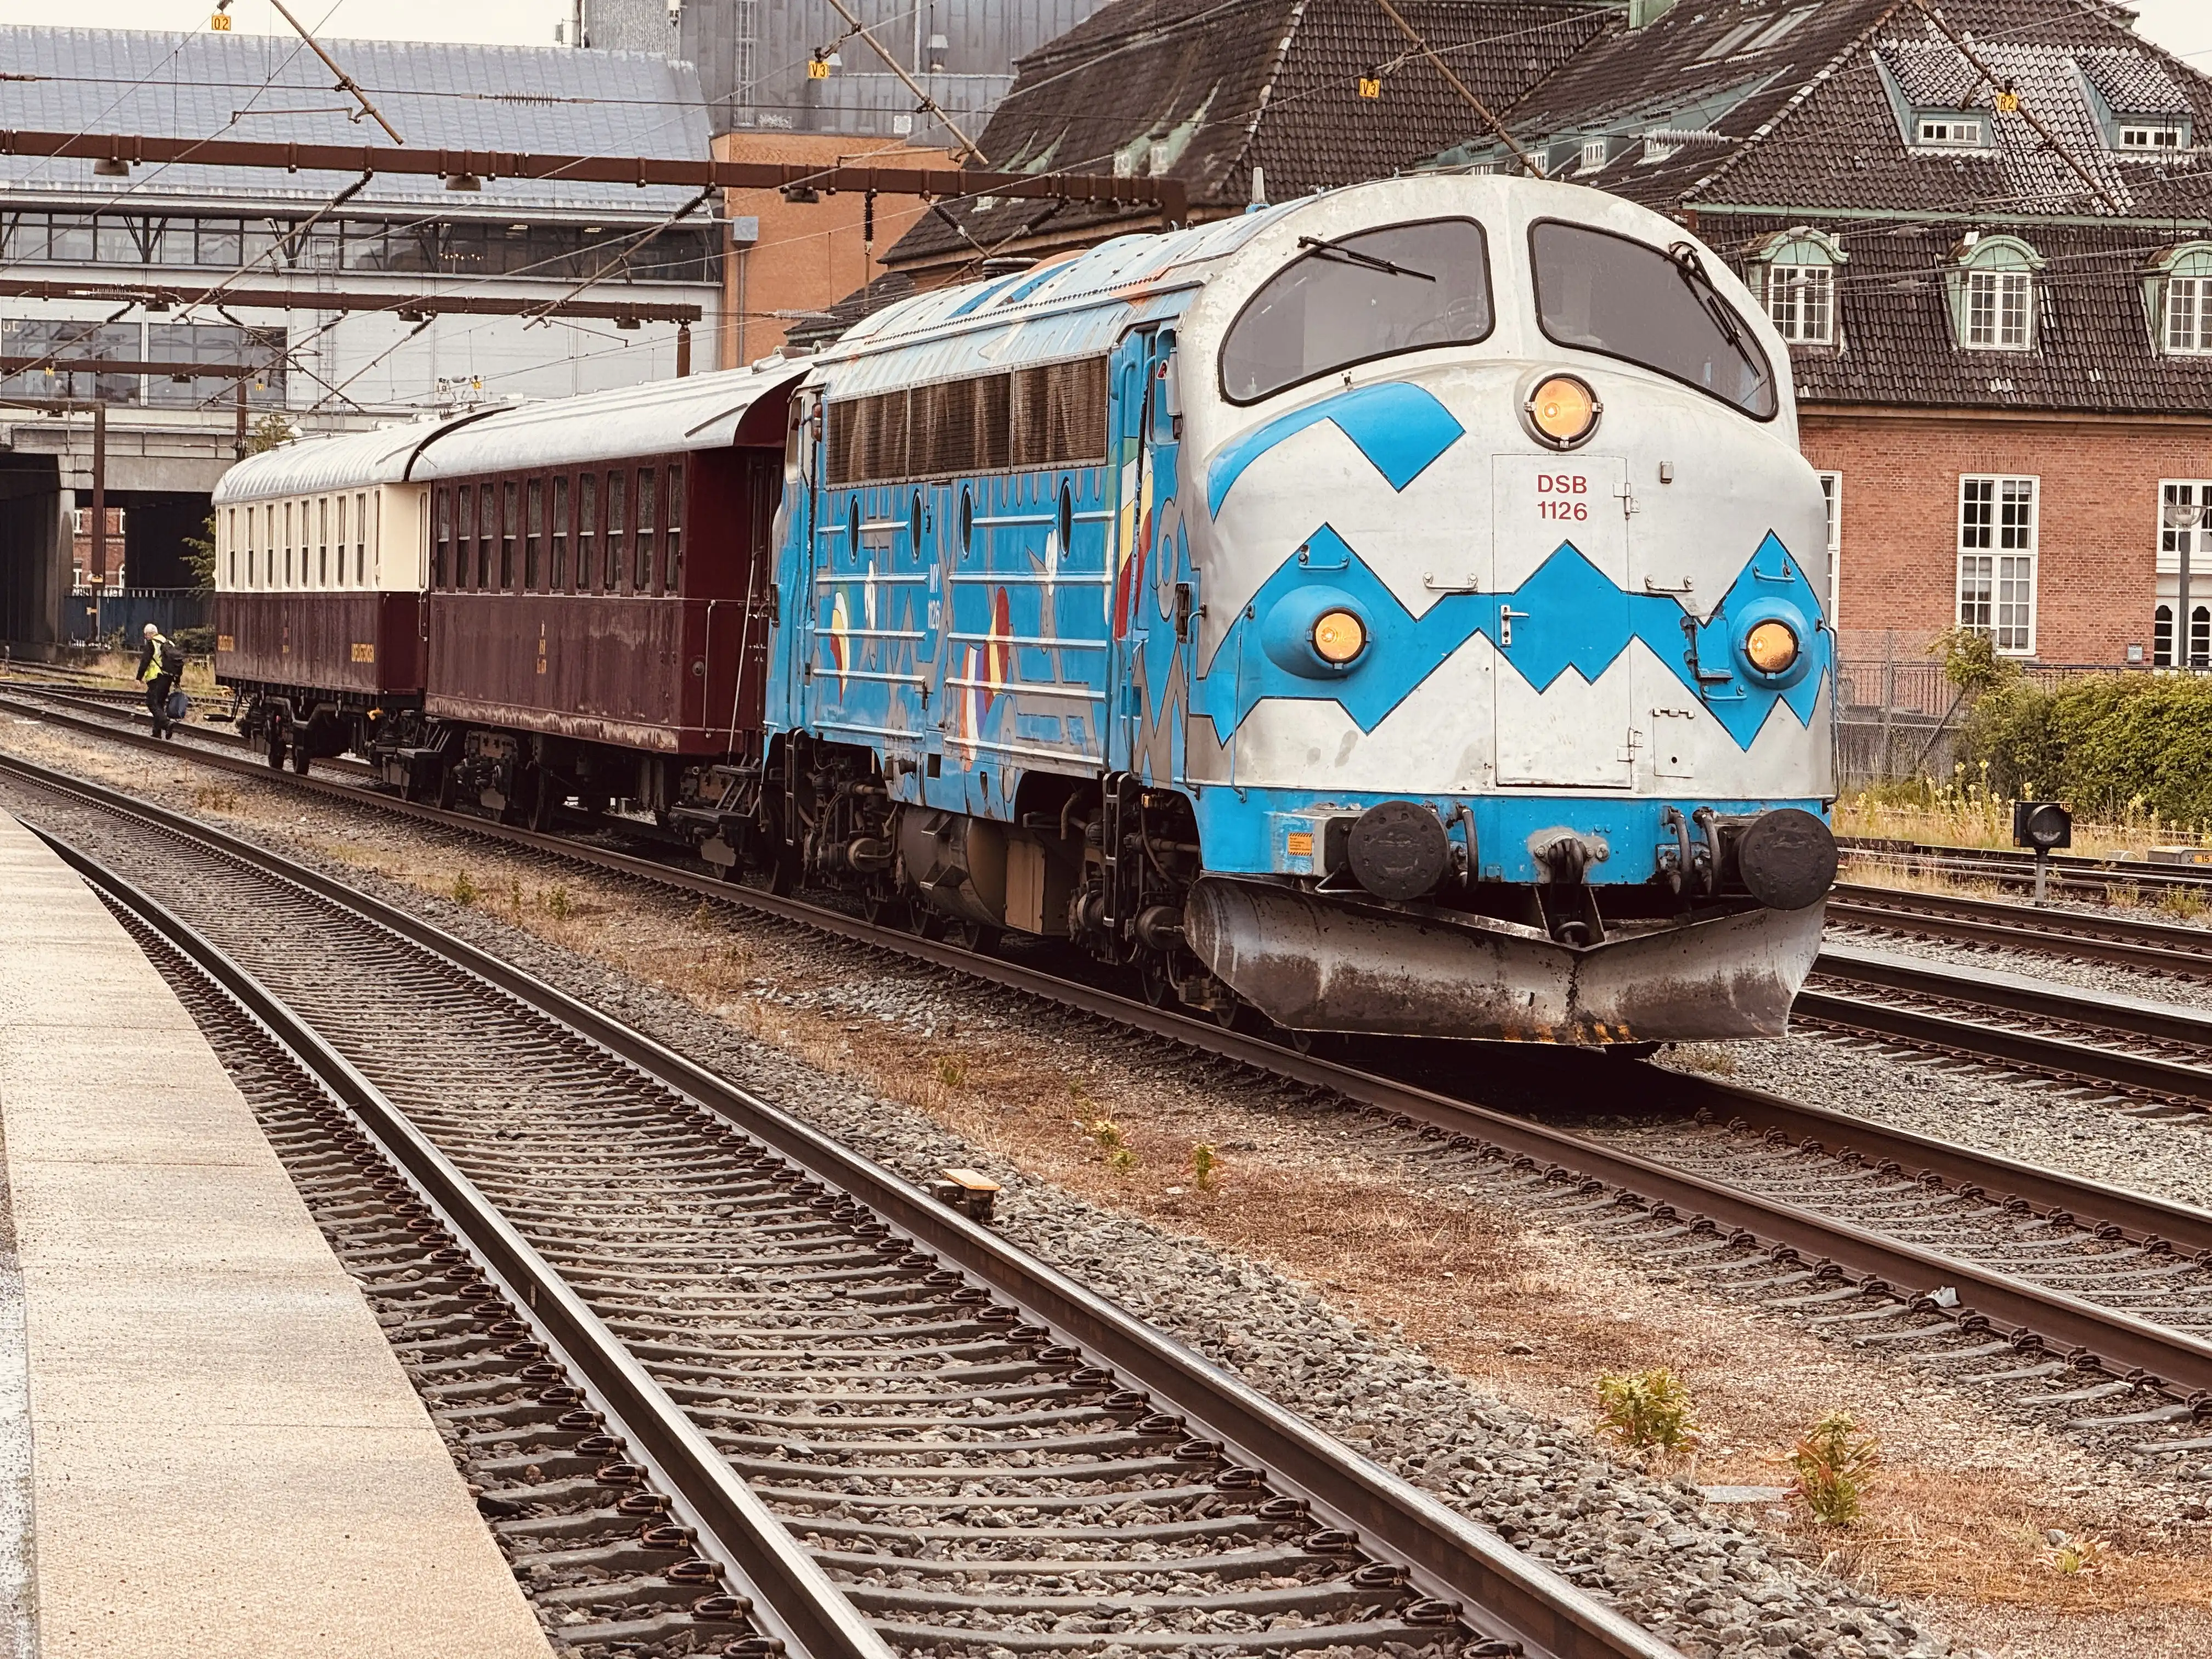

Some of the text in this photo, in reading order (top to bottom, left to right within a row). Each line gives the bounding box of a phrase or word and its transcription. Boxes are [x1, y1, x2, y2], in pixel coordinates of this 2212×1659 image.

[812, 64, 825, 77] V3
[1363, 82, 1376, 95] V3
[2000, 97, 2014, 109] R2
[1538, 475, 1587, 493] DSB
[1537, 501, 1588, 521] 1126
[929, 562, 940, 593] MY
[928, 600, 940, 630] 1126
[2201, 855, 2210, 863] 15
